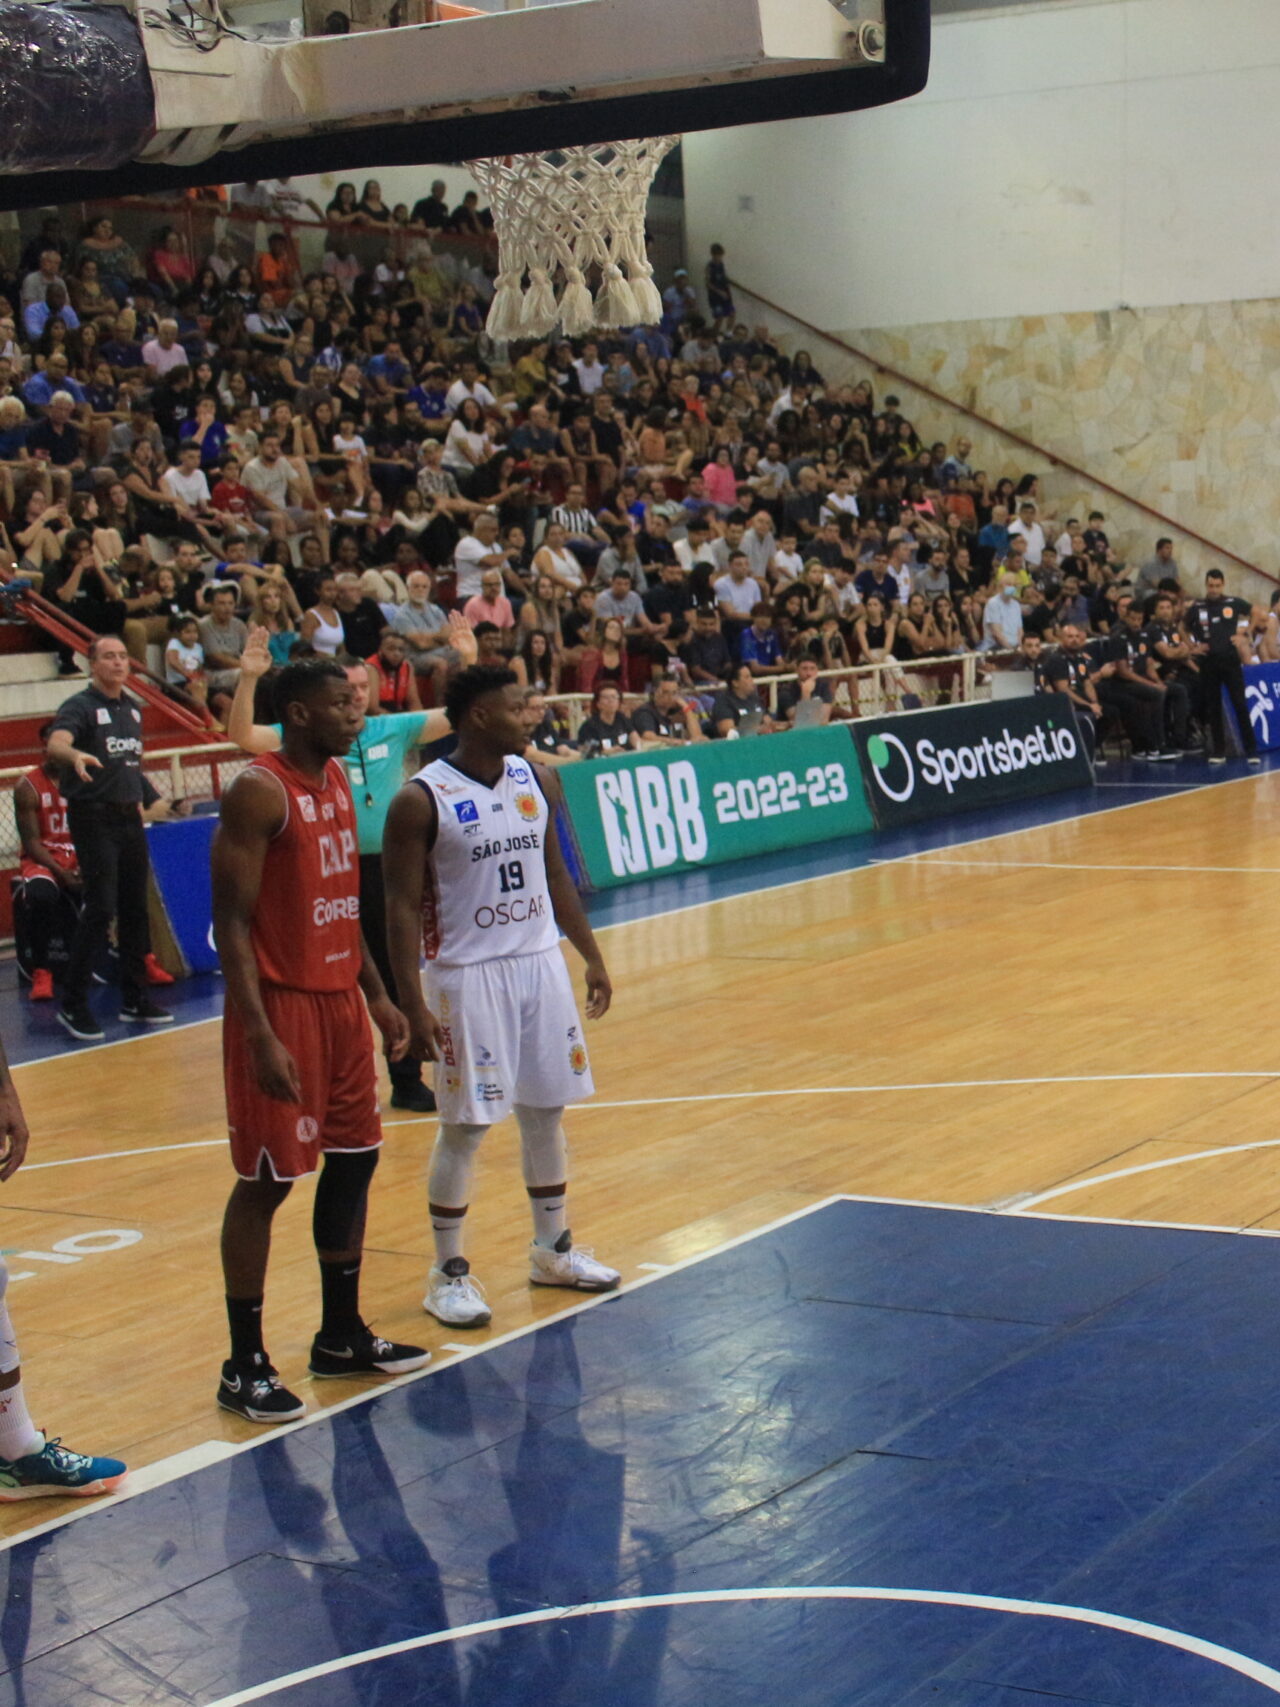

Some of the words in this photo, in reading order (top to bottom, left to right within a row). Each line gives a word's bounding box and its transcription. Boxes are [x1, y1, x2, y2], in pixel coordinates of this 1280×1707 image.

[916, 719, 1077, 794] Sportsbet.io
[595, 760, 709, 877] NBB
[713, 762, 848, 824] 2022-23
[319, 829, 356, 878] CAP
[471, 839, 502, 863] SÃO
[504, 829, 540, 851] JOSÉ
[498, 860, 525, 893] 19
